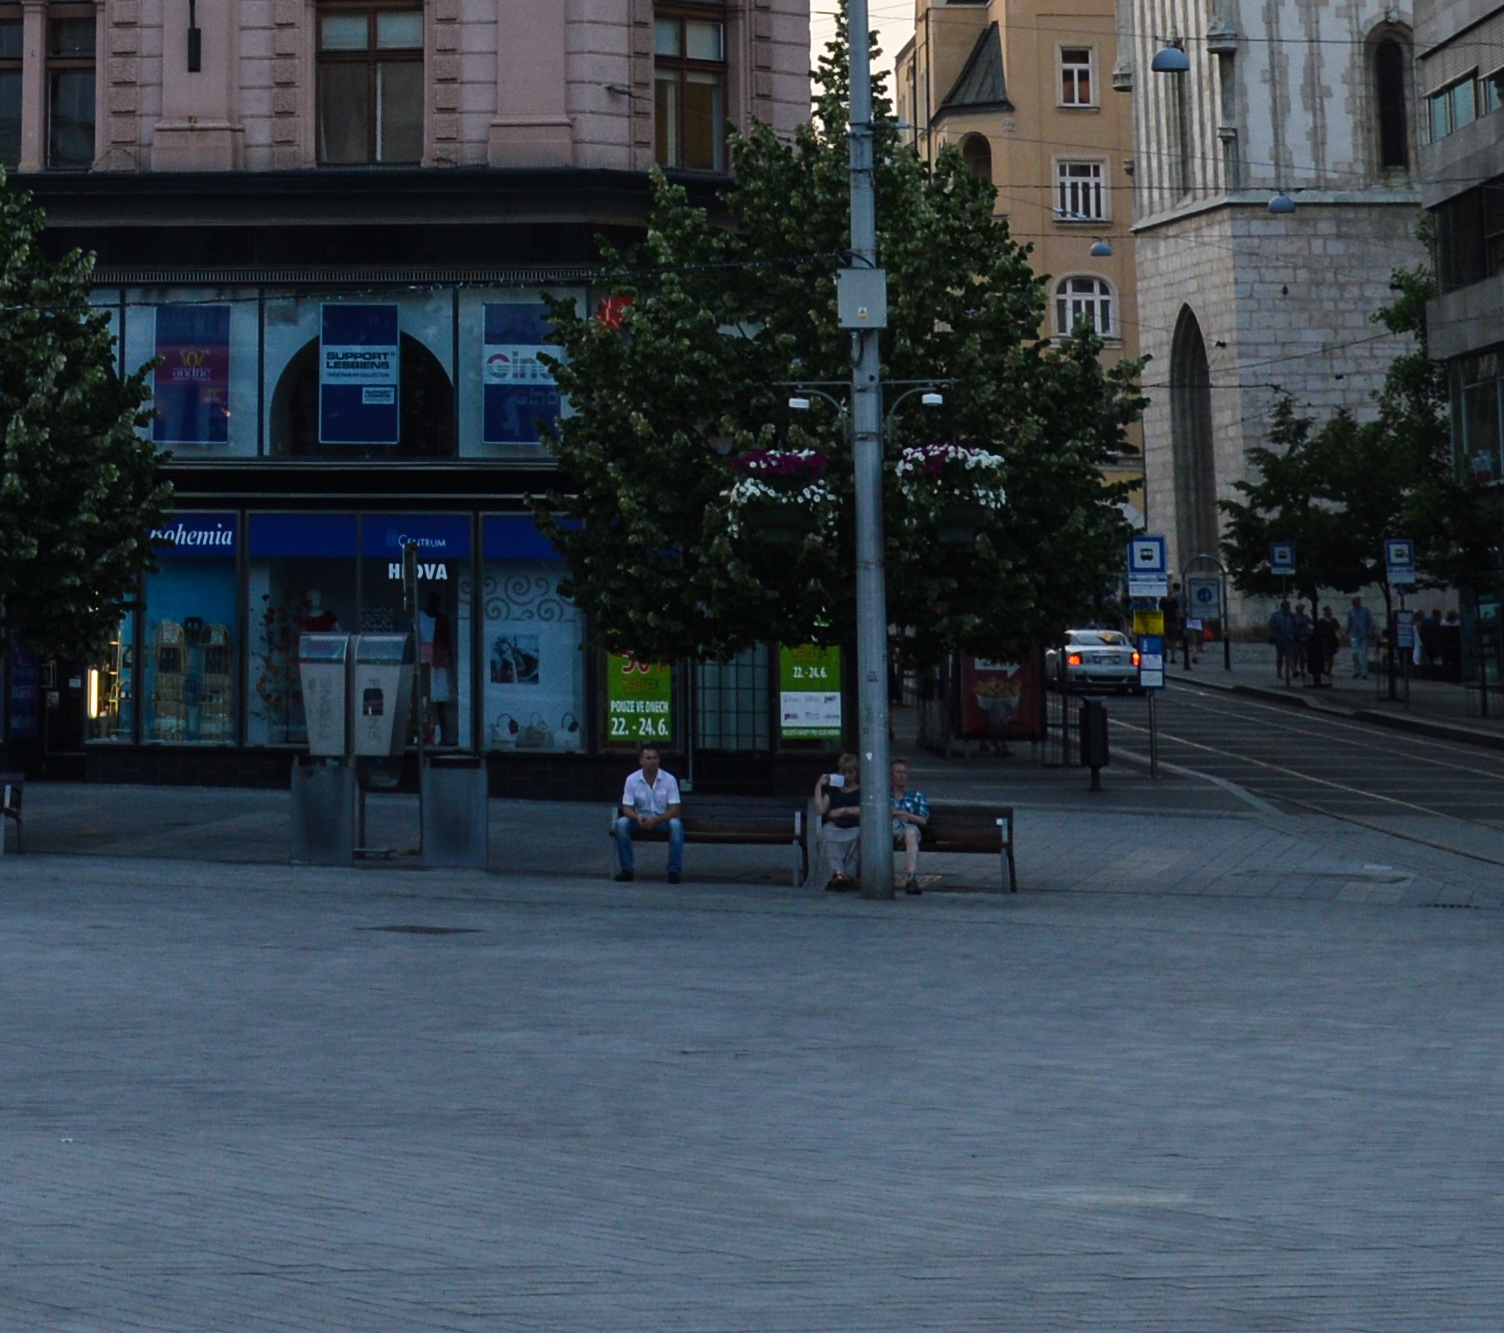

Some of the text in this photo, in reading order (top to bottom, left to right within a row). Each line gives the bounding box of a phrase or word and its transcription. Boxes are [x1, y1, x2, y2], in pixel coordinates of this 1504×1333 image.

[326, 351, 389, 360] SUPPORT
[326, 361, 389, 369] LESBIENS
[611, 700, 634, 713] POUZE
[636, 700, 645, 713] VE
[611, 717, 629, 735] 22.
[639, 717, 655, 735] 24.
[658, 717, 669, 735] 6.
